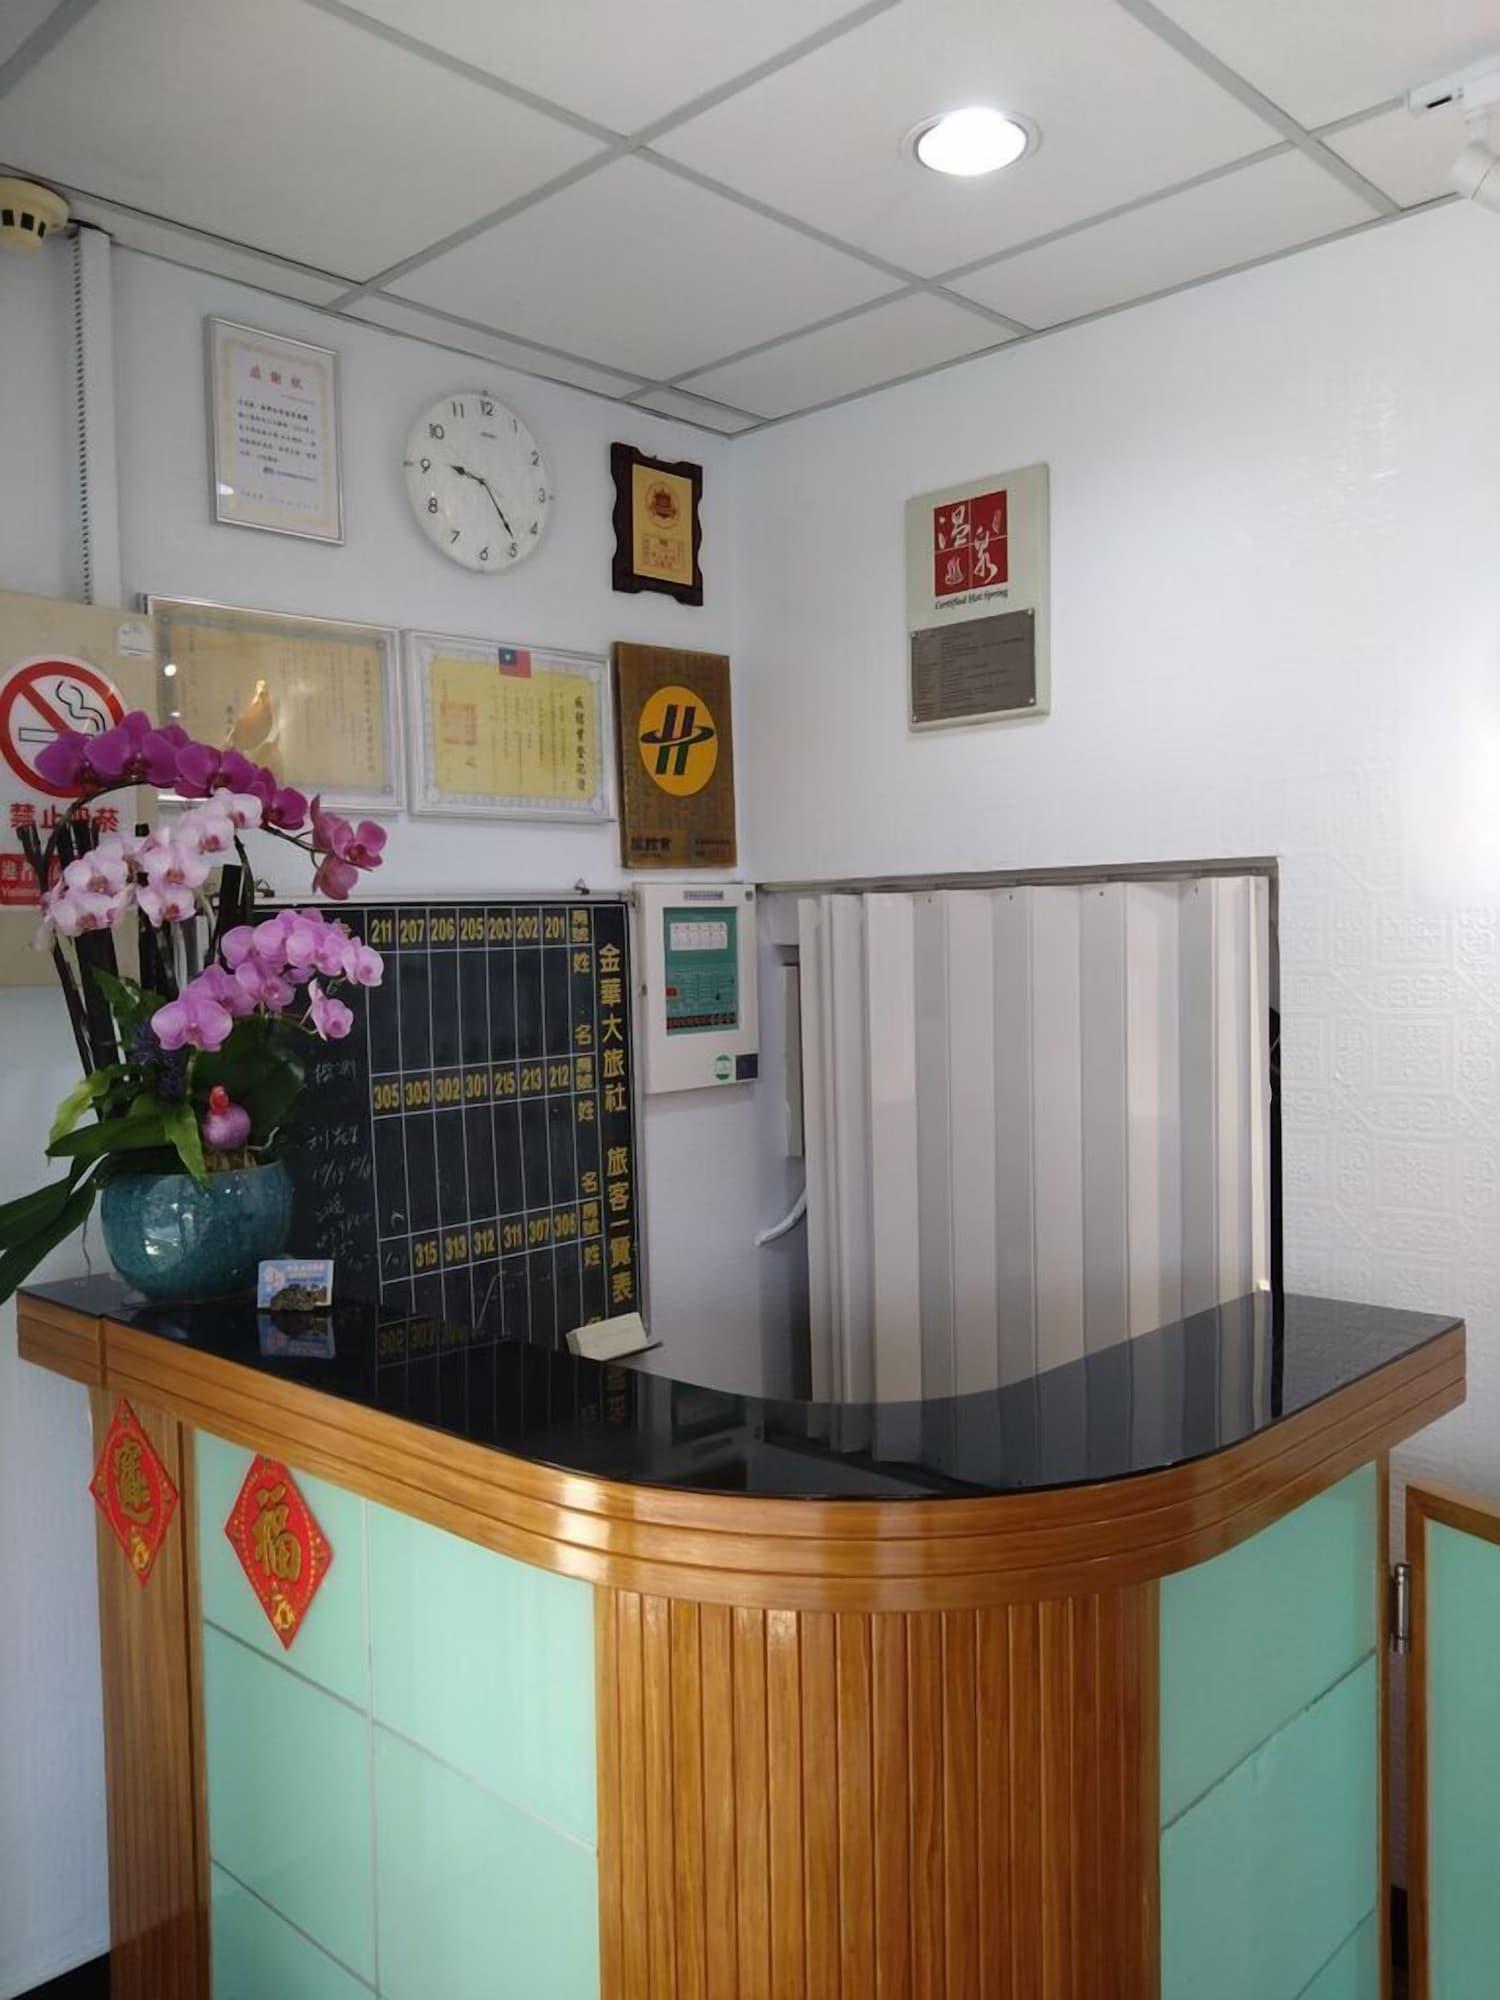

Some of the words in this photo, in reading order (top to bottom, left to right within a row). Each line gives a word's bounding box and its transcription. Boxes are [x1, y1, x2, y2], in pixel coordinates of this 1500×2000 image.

[452, 401, 465, 419] 11
[480, 400, 494, 416] 12
[429, 423, 445, 440] 10
[512, 418, 518, 433] 1
[420, 458, 431, 474] 9
[530, 450, 539, 467] 2
[538, 488, 546, 503] 3
[428, 497, 438, 514] 8
[530, 521, 538, 535] 4
[451, 530, 461, 544] 7
[479, 546, 489, 561] 6
[509, 542, 518, 558] 5
[371, 919, 392, 944] 211
[400, 919, 425, 943] 207
[430, 918, 456, 942] 206
[460, 918, 484, 940] 205
[487, 918, 512, 940] 203
[516, 917, 539, 939] 202
[544, 917, 565, 939] 201
[599, 943, 626, 1113] 金華大旅社
[373, 1085, 400, 1111] 305
[403, 1080, 431, 1107] 303
[435, 1077, 461, 1103] 302
[465, 1074, 487, 1098] 301
[495, 1071, 515, 1095] 215
[521, 1069, 543, 1091] 213
[549, 1064, 570, 1089] 212
[414, 1241, 438, 1268] 315
[444, 1234, 468, 1262] 313
[474, 1229, 495, 1255] 312
[503, 1224, 525, 1249] 311
[528, 1218, 551, 1244] 307
